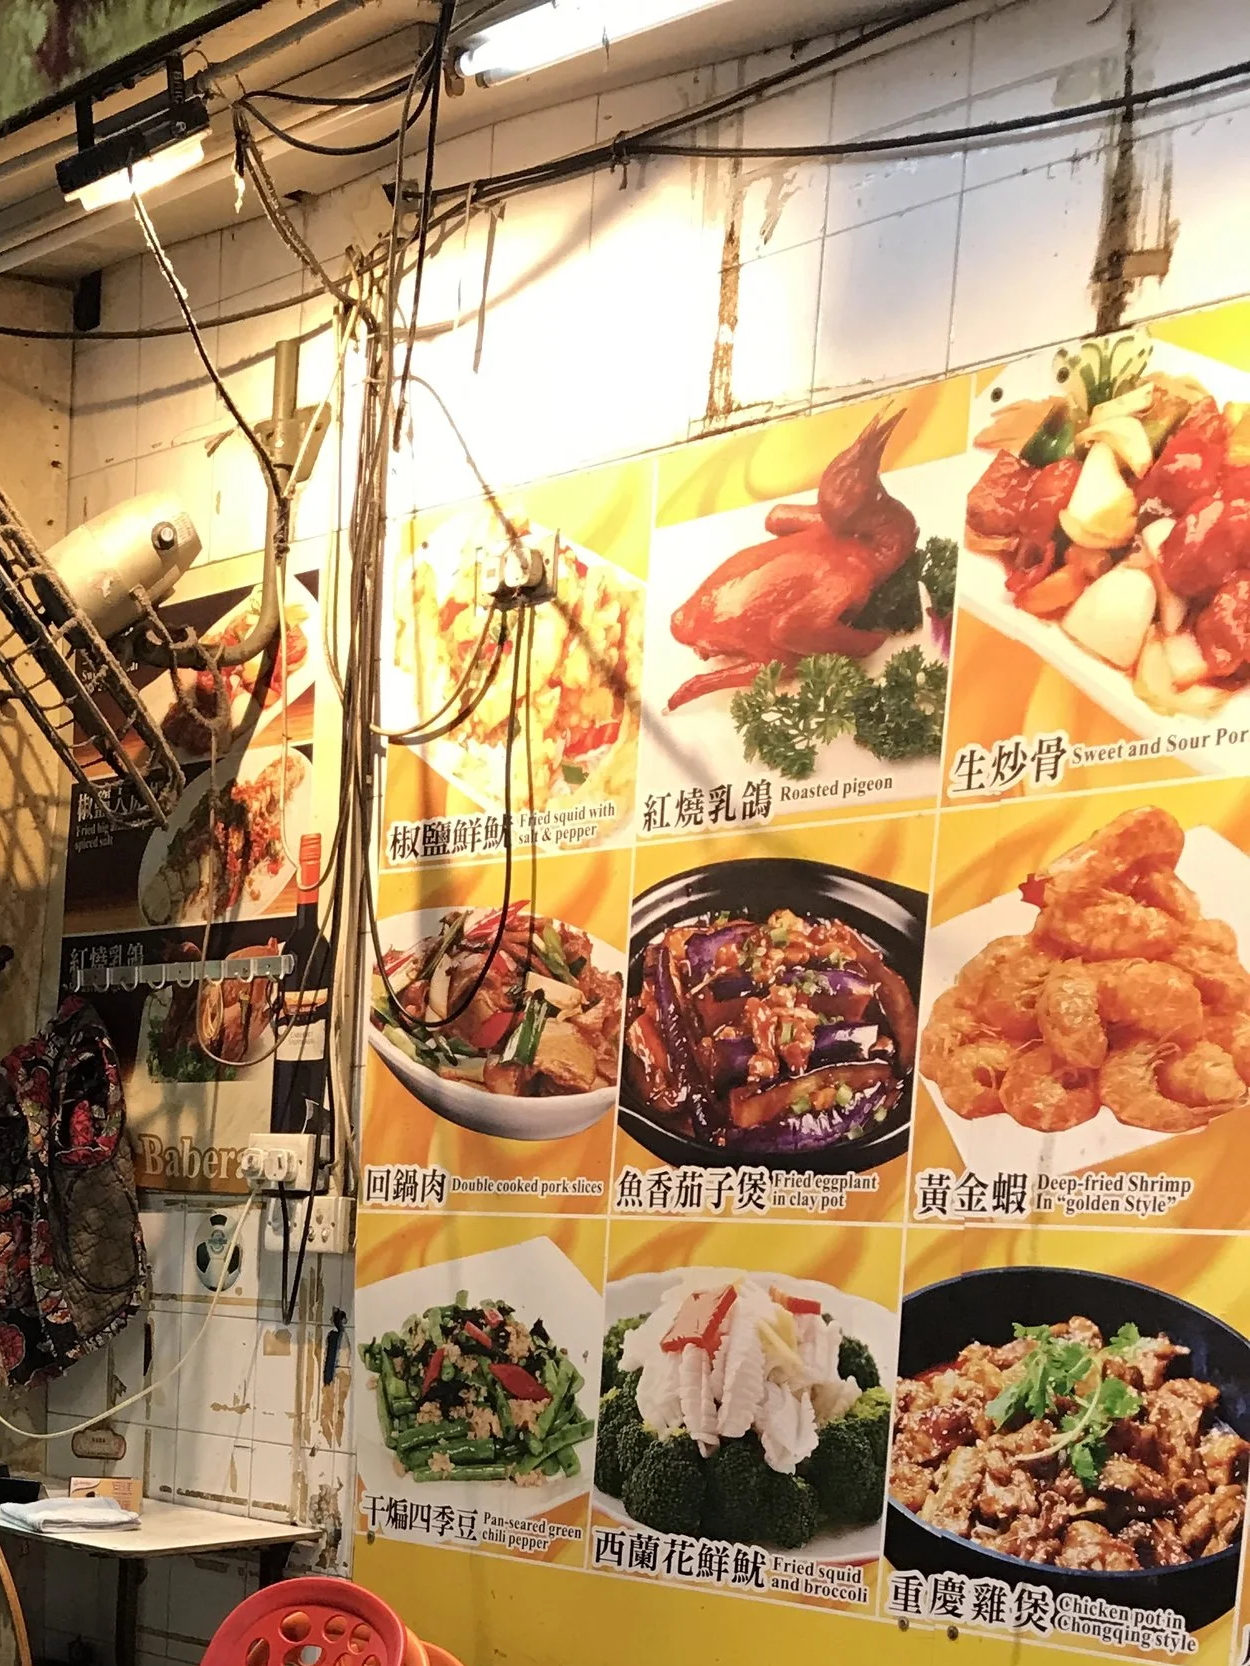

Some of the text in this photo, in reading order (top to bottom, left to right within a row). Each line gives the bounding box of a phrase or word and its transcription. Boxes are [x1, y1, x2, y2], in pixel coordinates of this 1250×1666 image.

[1072, 742, 1123, 765] Sweet
[1127, 737, 1161, 758] and
[1165, 732, 1210, 752] Sour
[952, 736, 1067, 793] 生炒骨
[780, 777, 892, 801] Roasted pigeon
[520, 802, 615, 828] Fried squid with
[642, 778, 772, 832] 紅燒乳鴿
[390, 813, 513, 861] 椒鹽鮮魷
[518, 824, 598, 844] salt & pepper
[366, 1168, 446, 1203] 回鍋肉
[452, 1177, 602, 1196] Double cooked pork slices
[616, 1169, 767, 1211] 魚香茄子煲
[774, 1172, 877, 1193] Fried eggplant
[918, 1171, 1028, 1215] 黃金蝦
[1038, 1173, 1191, 1197] Deep-fried Shrimp
[773, 1191, 845, 1210] in clay pot
[1036, 1193, 1053, 1209] In
[363, 1495, 478, 1541] 干煸四季豆
[483, 1511, 582, 1540] Pan-seared green
[482, 1528, 550, 1550] chili pepper
[595, 1530, 767, 1588] 西蘭花鮮魷
[773, 1556, 862, 1584] Fried squid
[771, 1576, 868, 1603] and broccoli
[889, 1575, 1050, 1633] 重慶雞煲
[1058, 1597, 1183, 1630] Chicken pot in
[1057, 1615, 1197, 1653] Chongqing style
